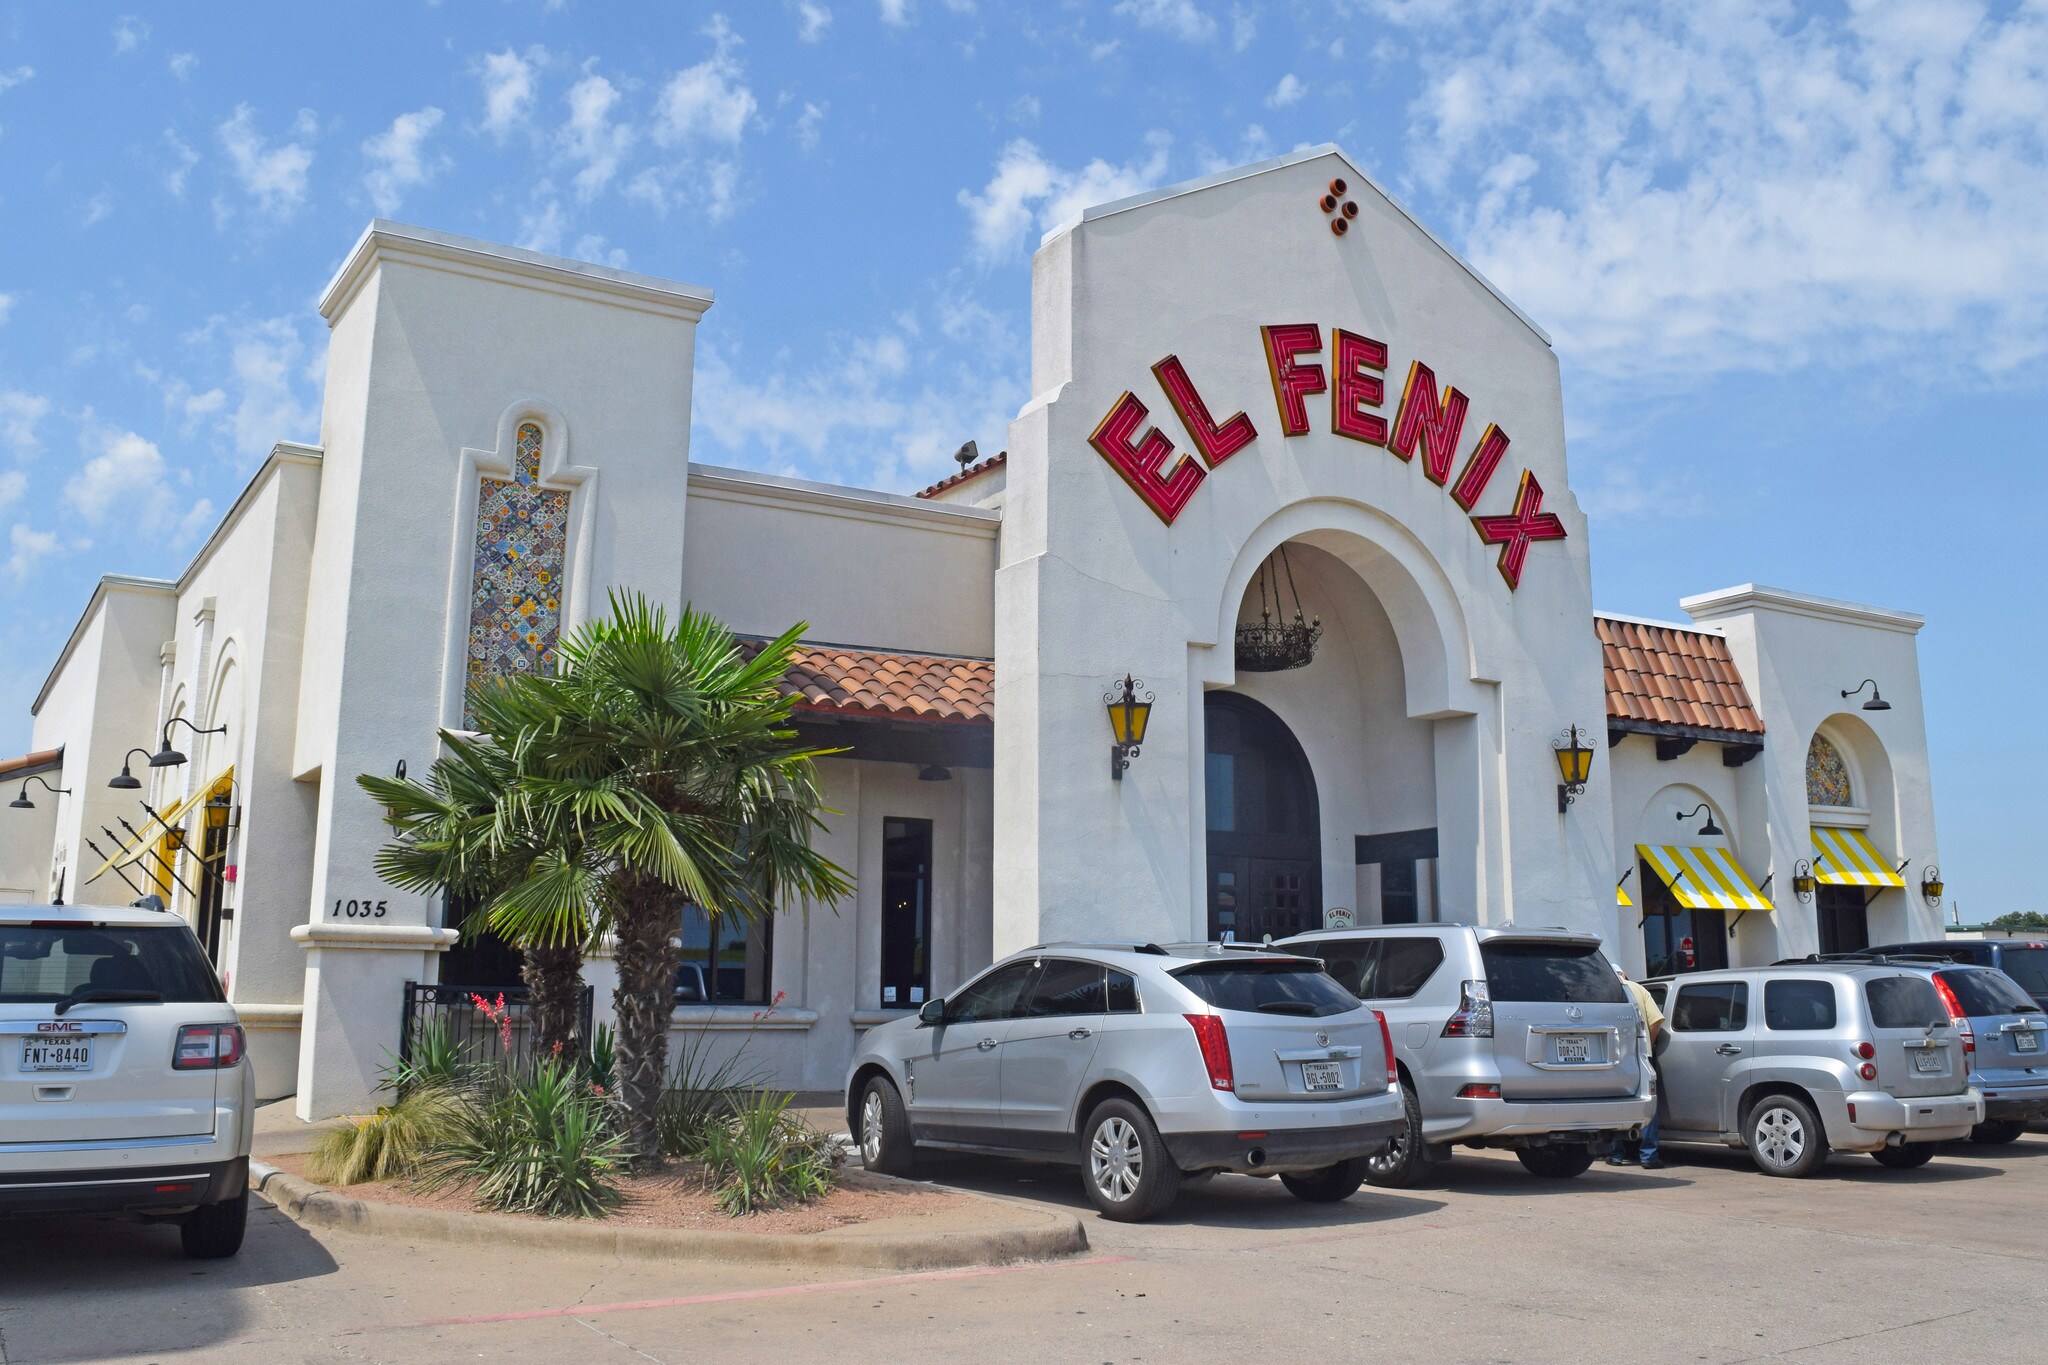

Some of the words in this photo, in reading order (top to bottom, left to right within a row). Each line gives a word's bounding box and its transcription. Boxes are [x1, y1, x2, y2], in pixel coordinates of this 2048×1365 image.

[1087, 353, 1258, 528] EL
[1260, 323, 1568, 592] FENIX
[332, 899, 388, 918] 1035
[37, 1022, 82, 1032] GMC
